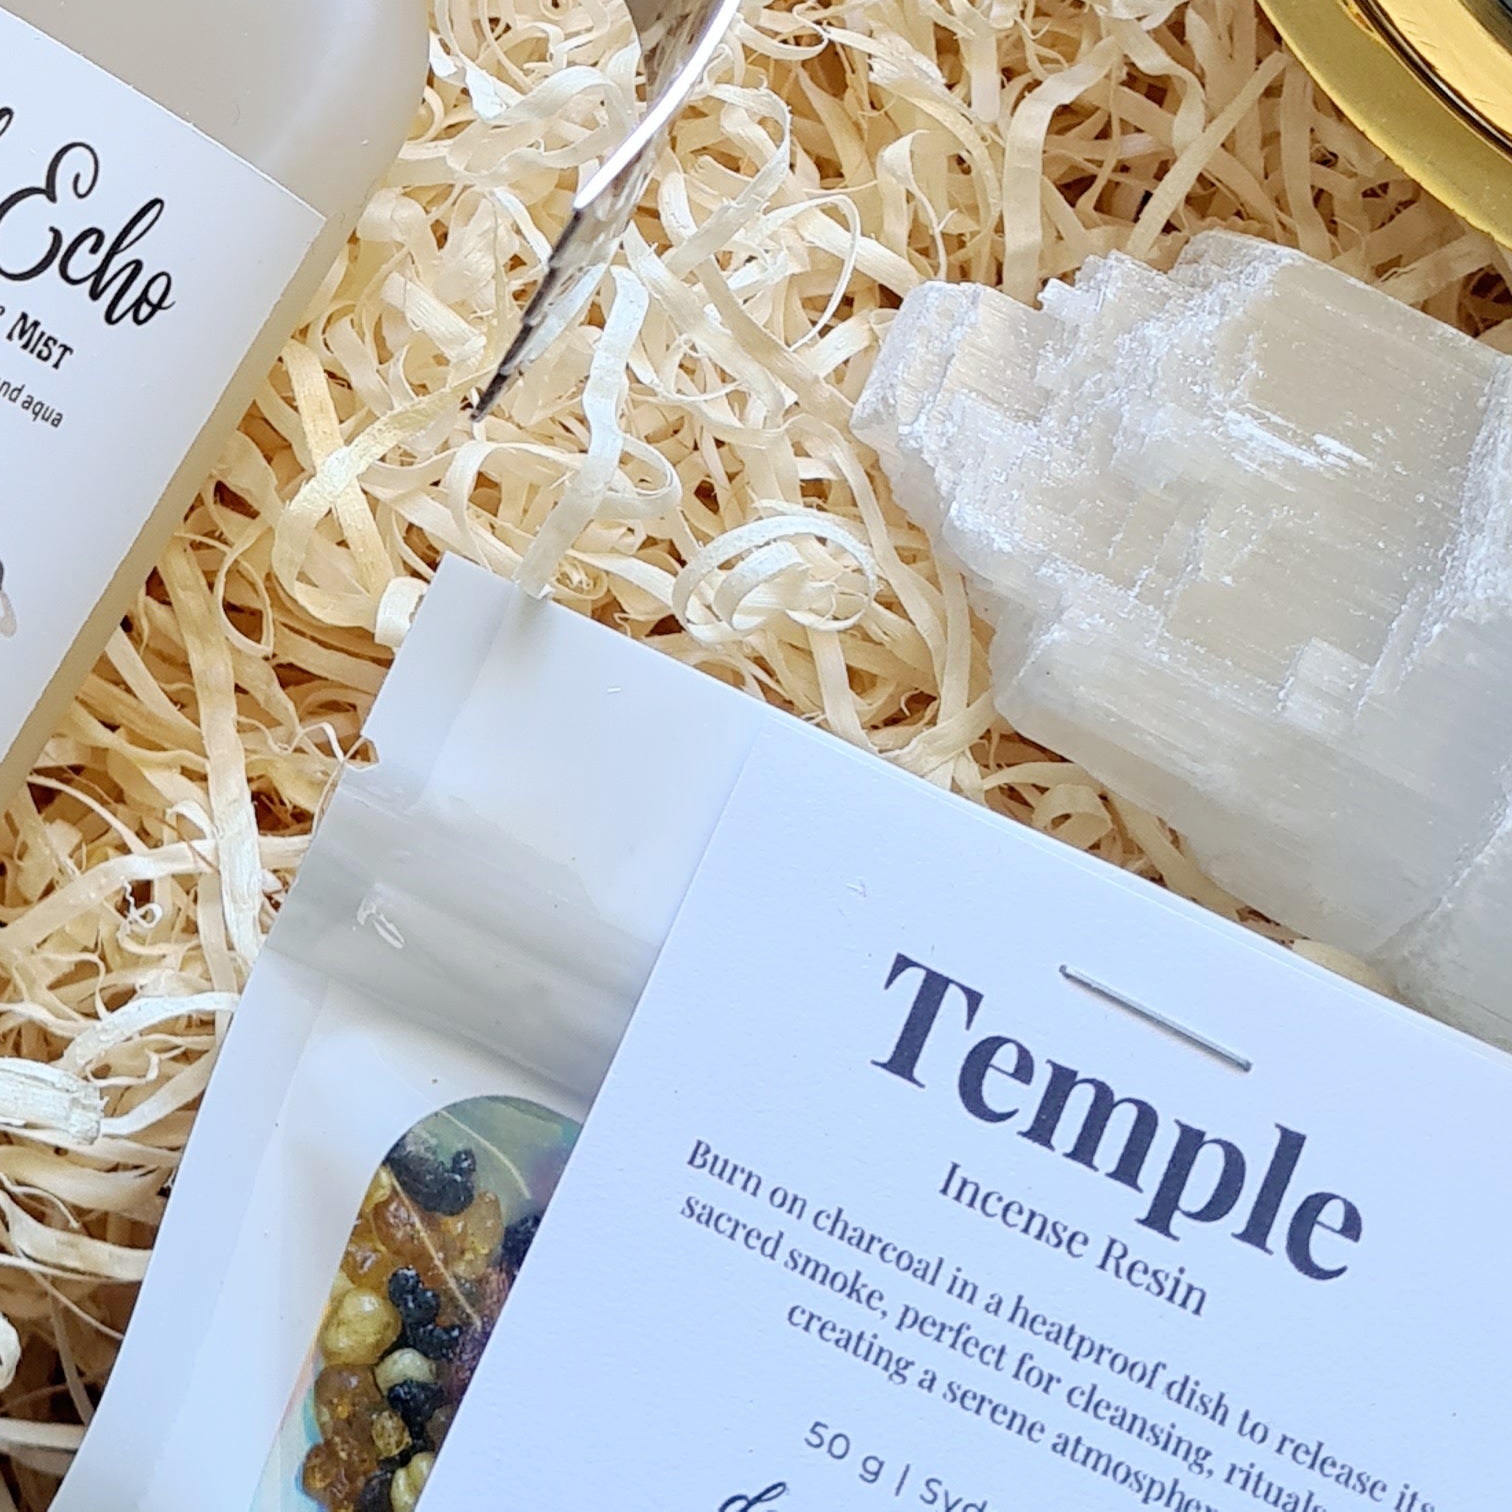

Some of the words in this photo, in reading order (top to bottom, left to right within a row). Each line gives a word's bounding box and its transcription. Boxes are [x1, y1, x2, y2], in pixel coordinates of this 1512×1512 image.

[22, 395, 62, 427] aqua
[871, 953, 1362, 1280] Temple
[939, 1162, 1089, 1257] Incense
[1097, 1238, 1206, 1315] Resin
[681, 1197, 784, 1260] sacred
[784, 1249, 887, 1318] smoke,
[895, 1303, 1007, 1373] perfect
[1012, 1353, 1061, 1394] for
[1067, 1384, 1213, 1477] cleansing,
[687, 1140, 761, 1197] Burn
[770, 1187, 806, 1219] on
[813, 1208, 943, 1286] charcoal
[947, 1275, 978, 1304] in
[985, 1294, 1002, 1316] a
[1008, 1295, 1166, 1389] heatproof
[1166, 1375, 1228, 1426] dish
[1238, 1410, 1268, 1444] to
[1275, 1435, 1386, 1501] release
[788, 1306, 915, 1384] creating
[918, 1370, 936, 1392] a
[943, 1381, 1045, 1443] serene
[805, 1422, 850, 1459] 50
[859, 1456, 884, 1483] g
